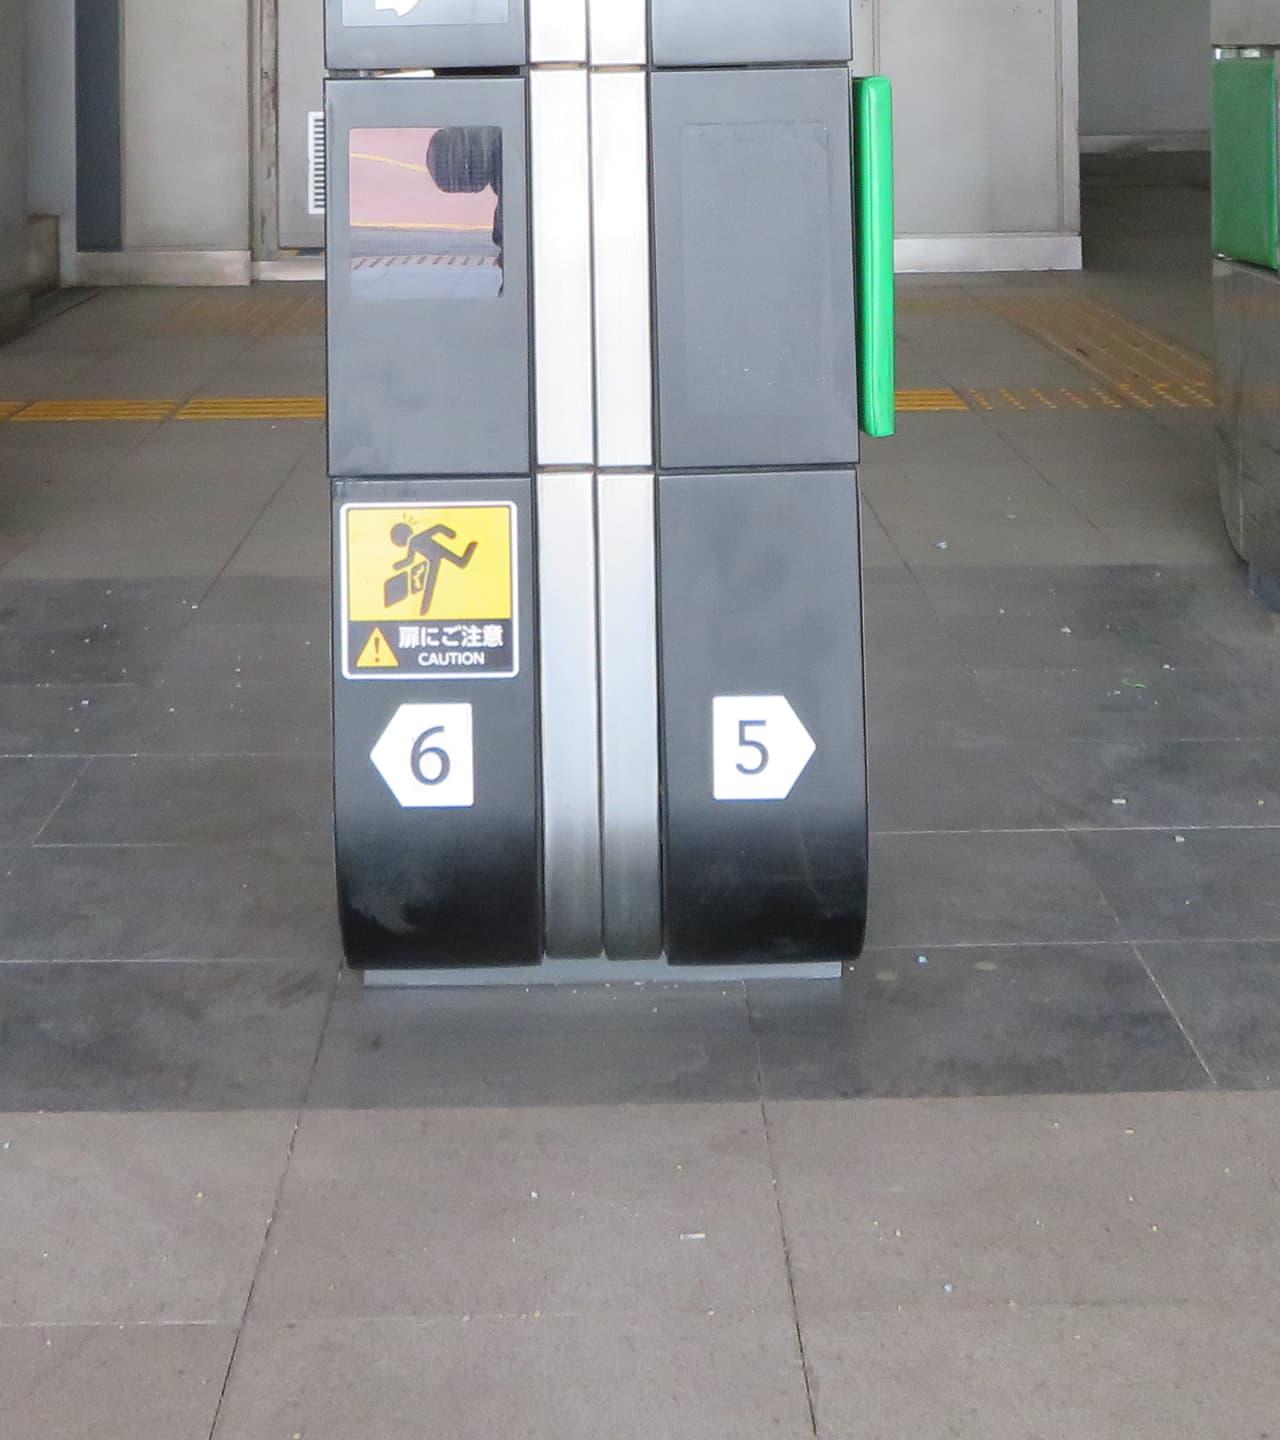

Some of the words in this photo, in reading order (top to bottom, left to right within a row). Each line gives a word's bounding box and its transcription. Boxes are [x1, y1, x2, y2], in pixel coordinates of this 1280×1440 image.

[398, 623, 504, 650] 扉にご注意
[417, 650, 486, 667] CAUTION
[410, 724, 452, 786] 6
[734, 719, 771, 776] 5
